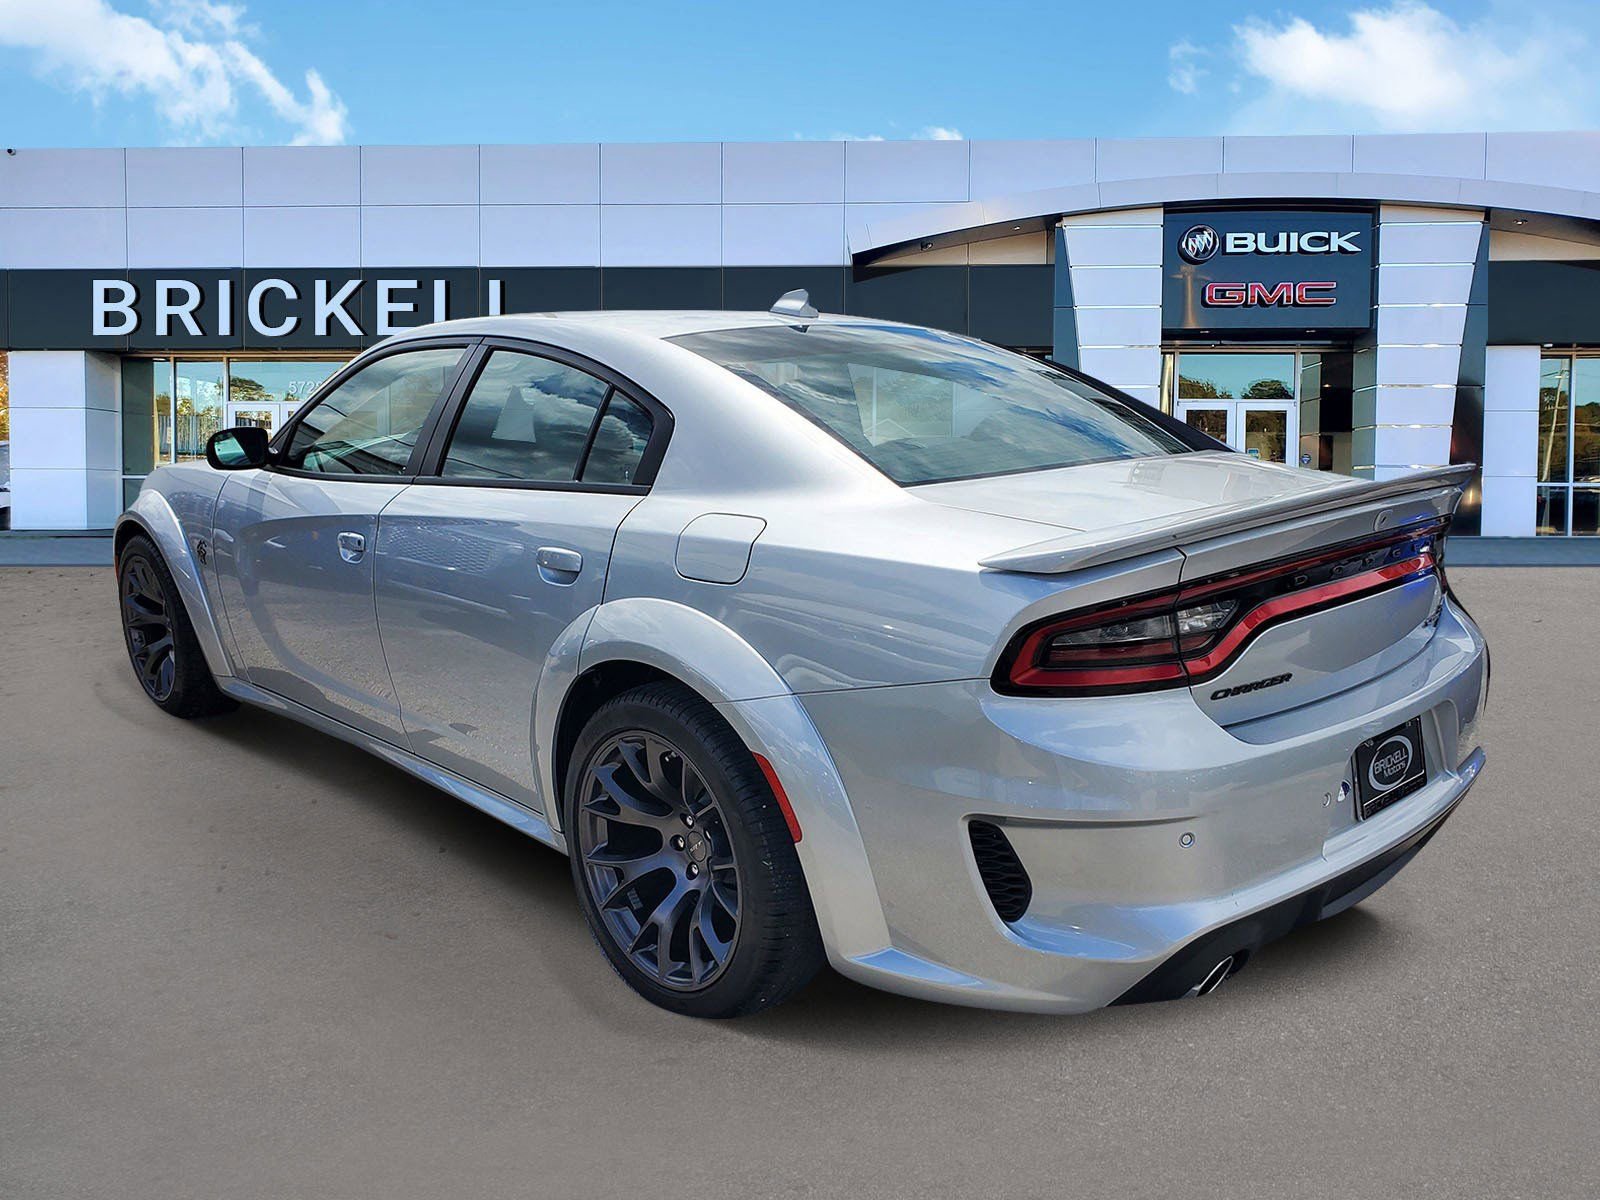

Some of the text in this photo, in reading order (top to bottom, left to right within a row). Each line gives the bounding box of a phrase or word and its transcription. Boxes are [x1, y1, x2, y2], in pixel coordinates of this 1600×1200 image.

[1225, 231, 1362, 253] BUICK
[1205, 281, 1337, 306] GMC
[1209, 672, 1293, 700] CHARGER
[1374, 748, 1408, 774] BRICKELL
